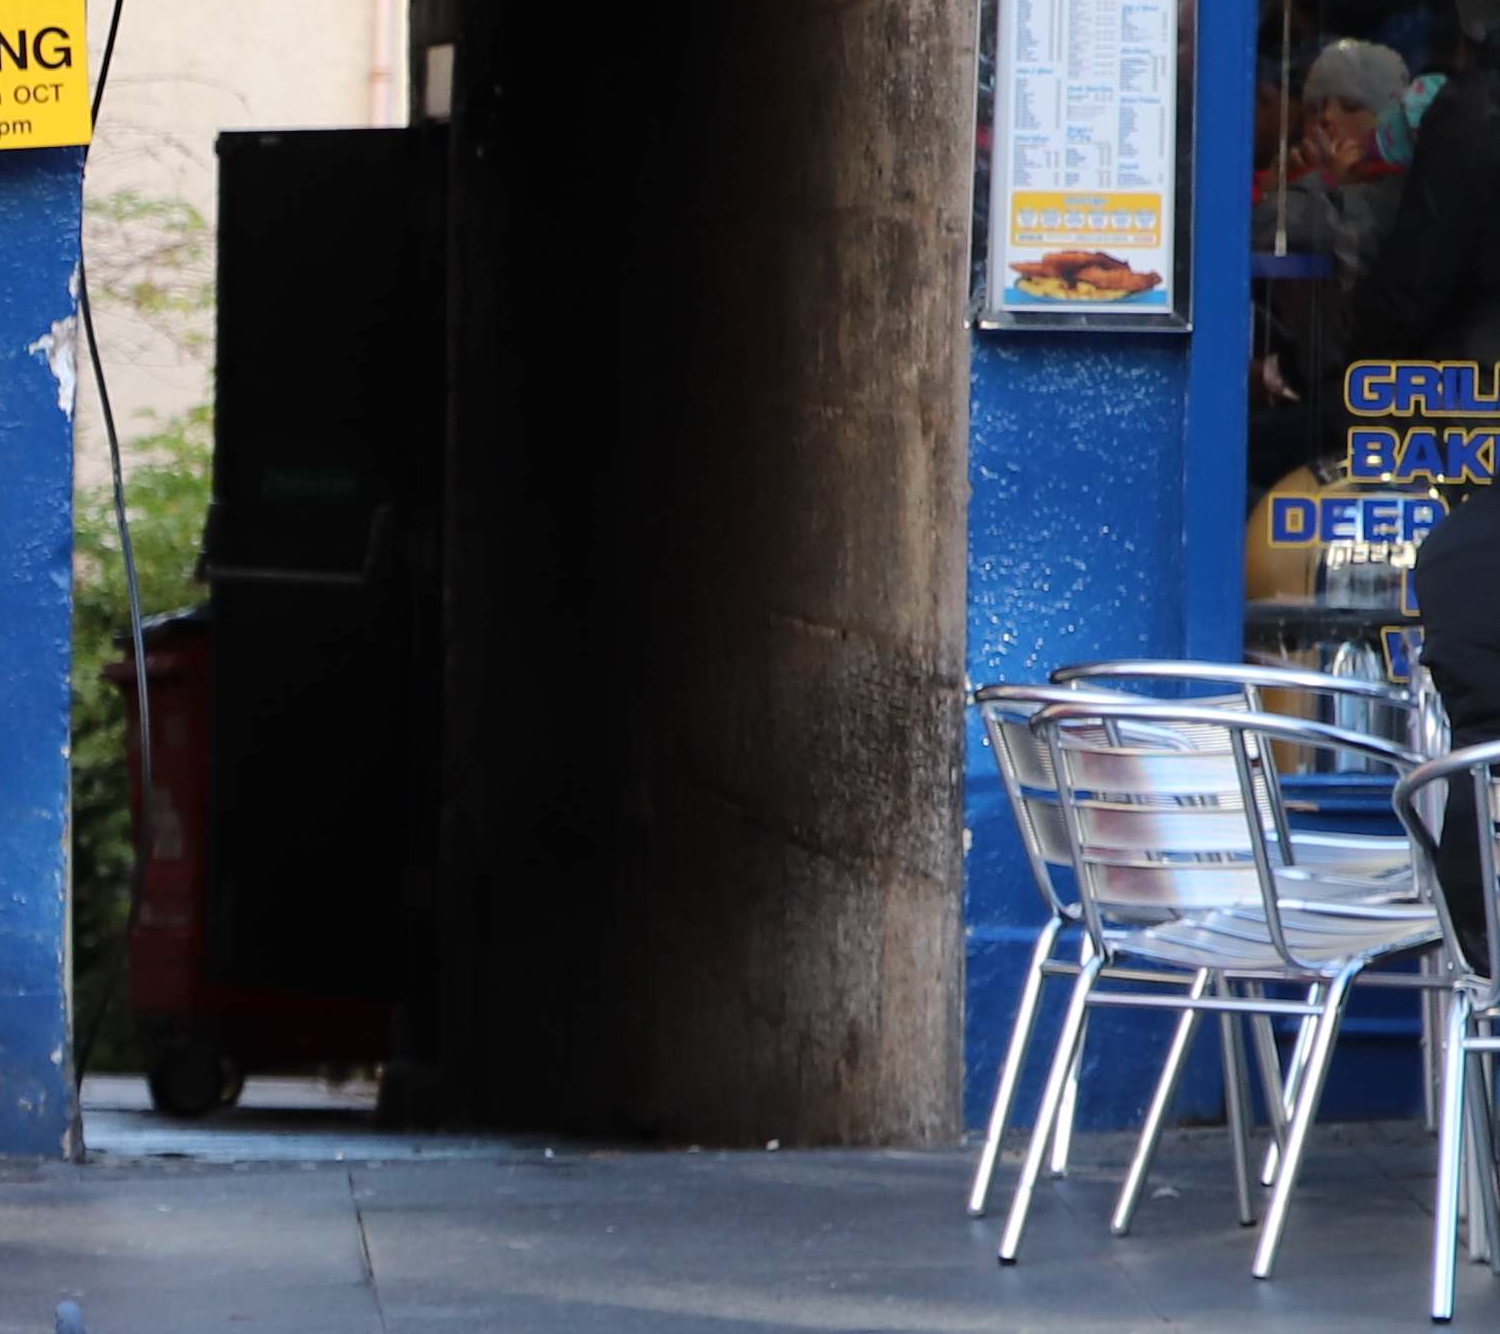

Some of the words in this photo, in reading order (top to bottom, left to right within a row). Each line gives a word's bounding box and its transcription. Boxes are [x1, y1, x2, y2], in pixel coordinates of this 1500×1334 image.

[13, 84, 64, 104] OCT
[1344, 359, 1500, 418] GRIL
[1346, 426, 1500, 485] BAK
